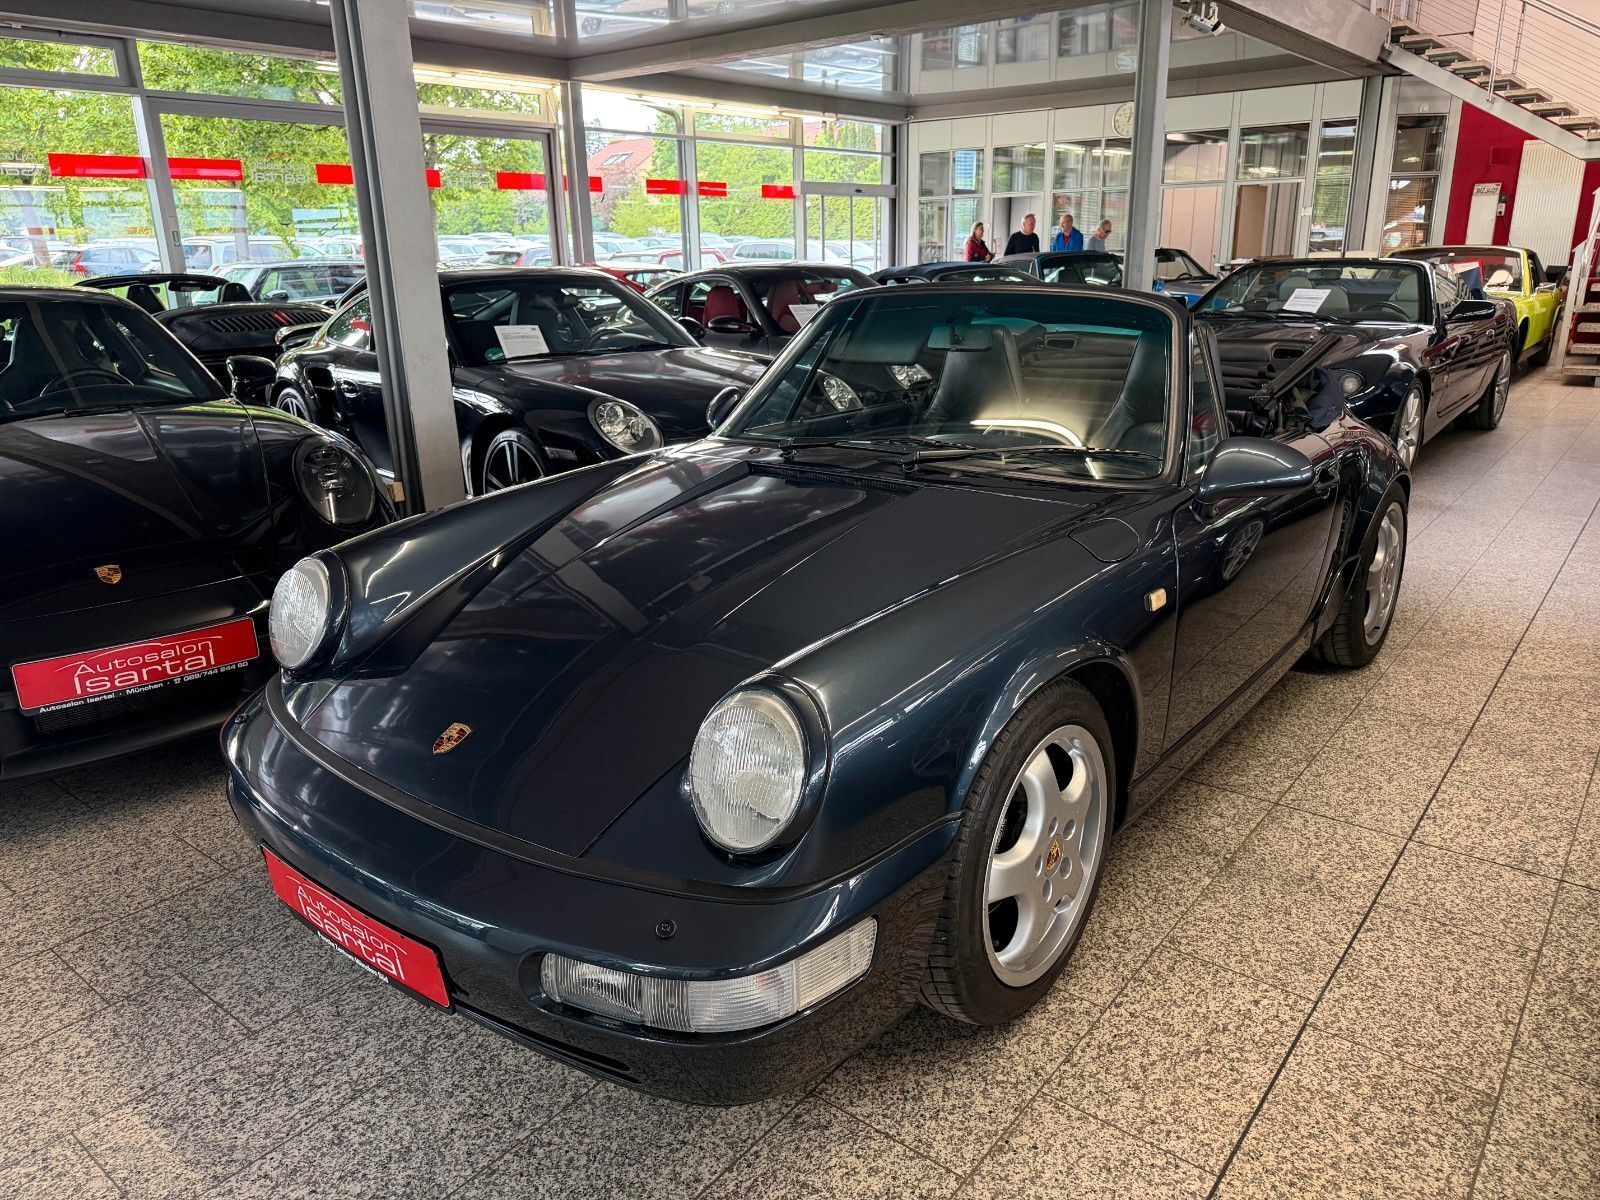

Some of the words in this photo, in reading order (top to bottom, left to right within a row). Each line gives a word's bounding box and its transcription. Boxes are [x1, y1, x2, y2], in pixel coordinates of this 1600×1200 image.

[74, 640, 212, 677] Autosalon
[74, 648, 215, 695] Isartal
[39, 700, 85, 713] Autosalon
[86, 693, 115, 704] Isartal
[126, 682, 164, 695] München
[298, 885, 399, 959] Autosalon
[298, 893, 405, 980] Isartal
